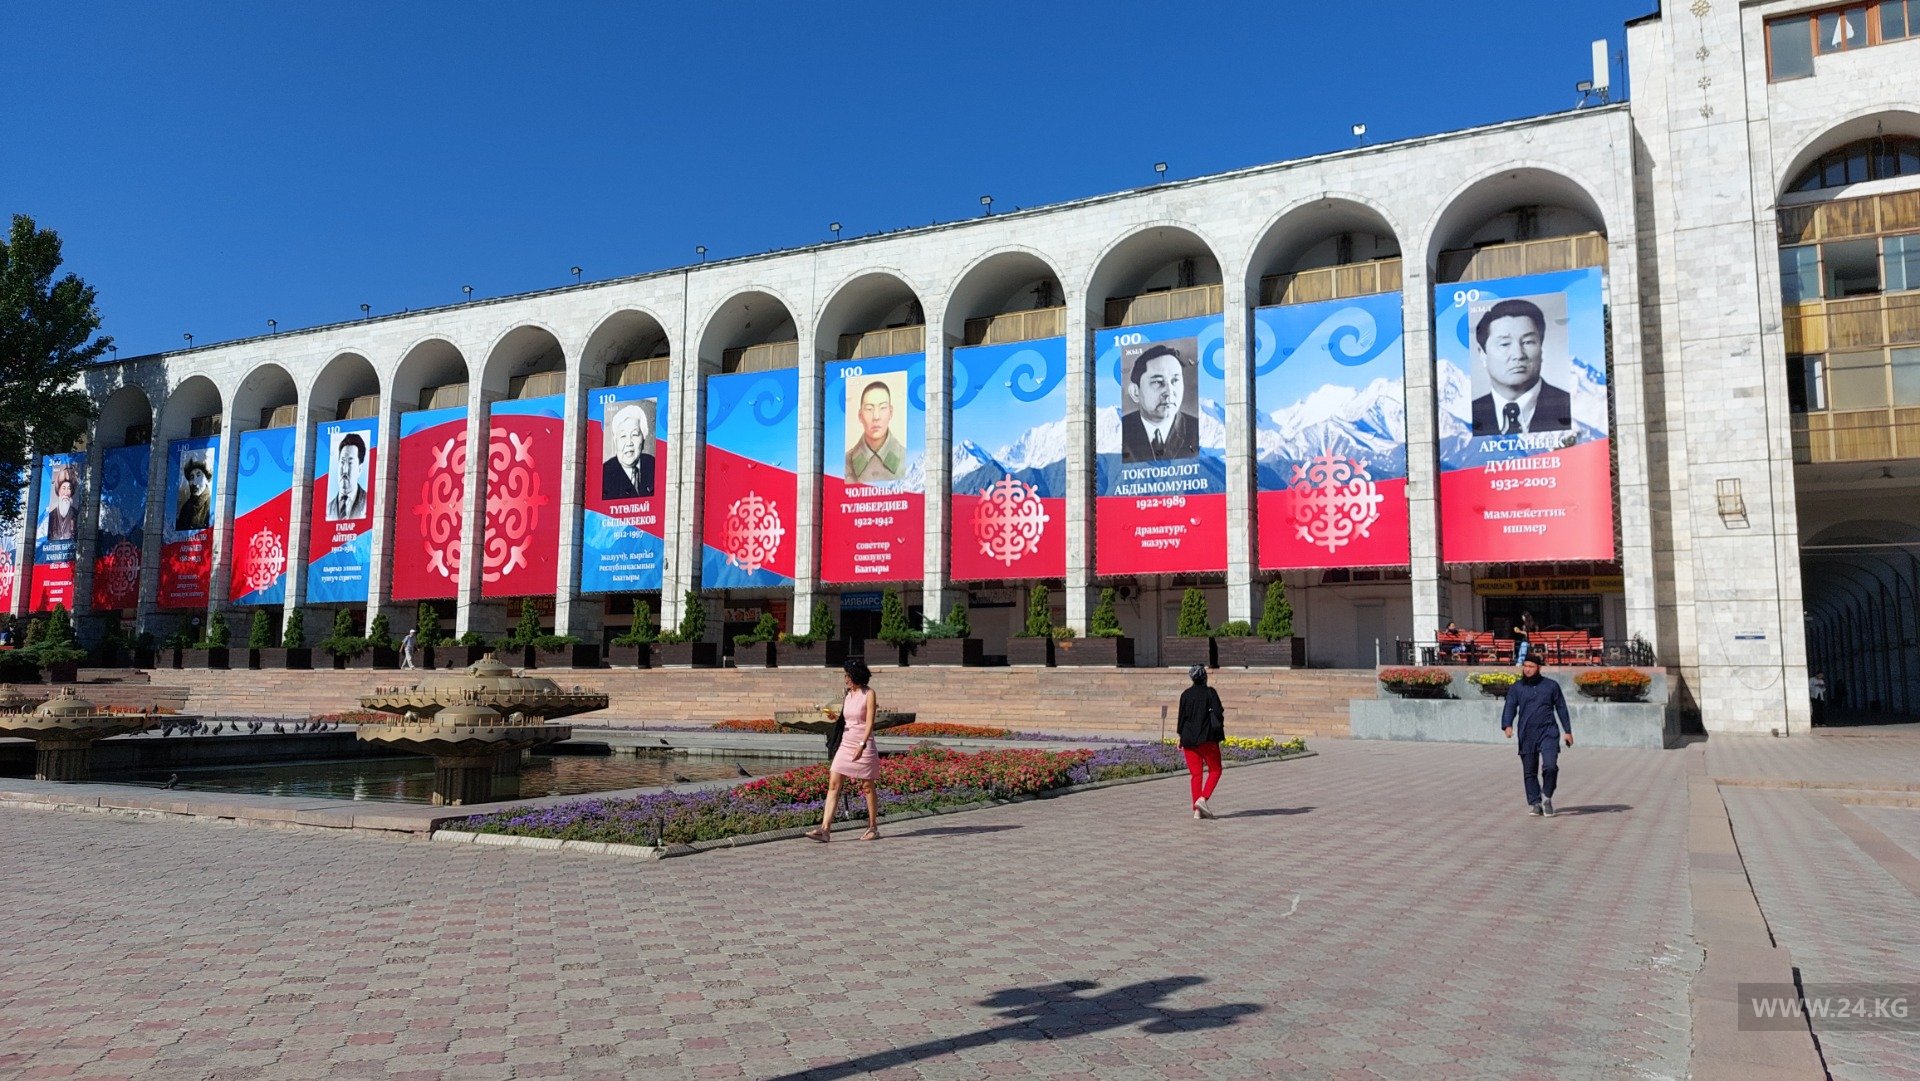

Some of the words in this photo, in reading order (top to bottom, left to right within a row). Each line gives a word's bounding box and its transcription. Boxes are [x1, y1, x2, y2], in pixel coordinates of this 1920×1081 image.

[1453, 289, 1480, 308] 90
[1114, 333, 1142, 347] 100
[840, 366, 863, 378] 100
[599, 394, 616, 404] 110
[1479, 438, 1565, 453] АРСТАНБЕК
[1121, 463, 1200, 480] ТОКТОБОЛОТ
[1114, 479, 1209, 496] АБДЫМОМУНОВ
[1490, 477, 1557, 491] 1932-2003
[1136, 496, 1186, 510] 1922-1989
[1483, 508, 1566, 520] мамлекеттик
[854, 517, 894, 528] 1922-1942
[1503, 524, 1547, 535] ишмер
[1135, 525, 1187, 537] драматург,
